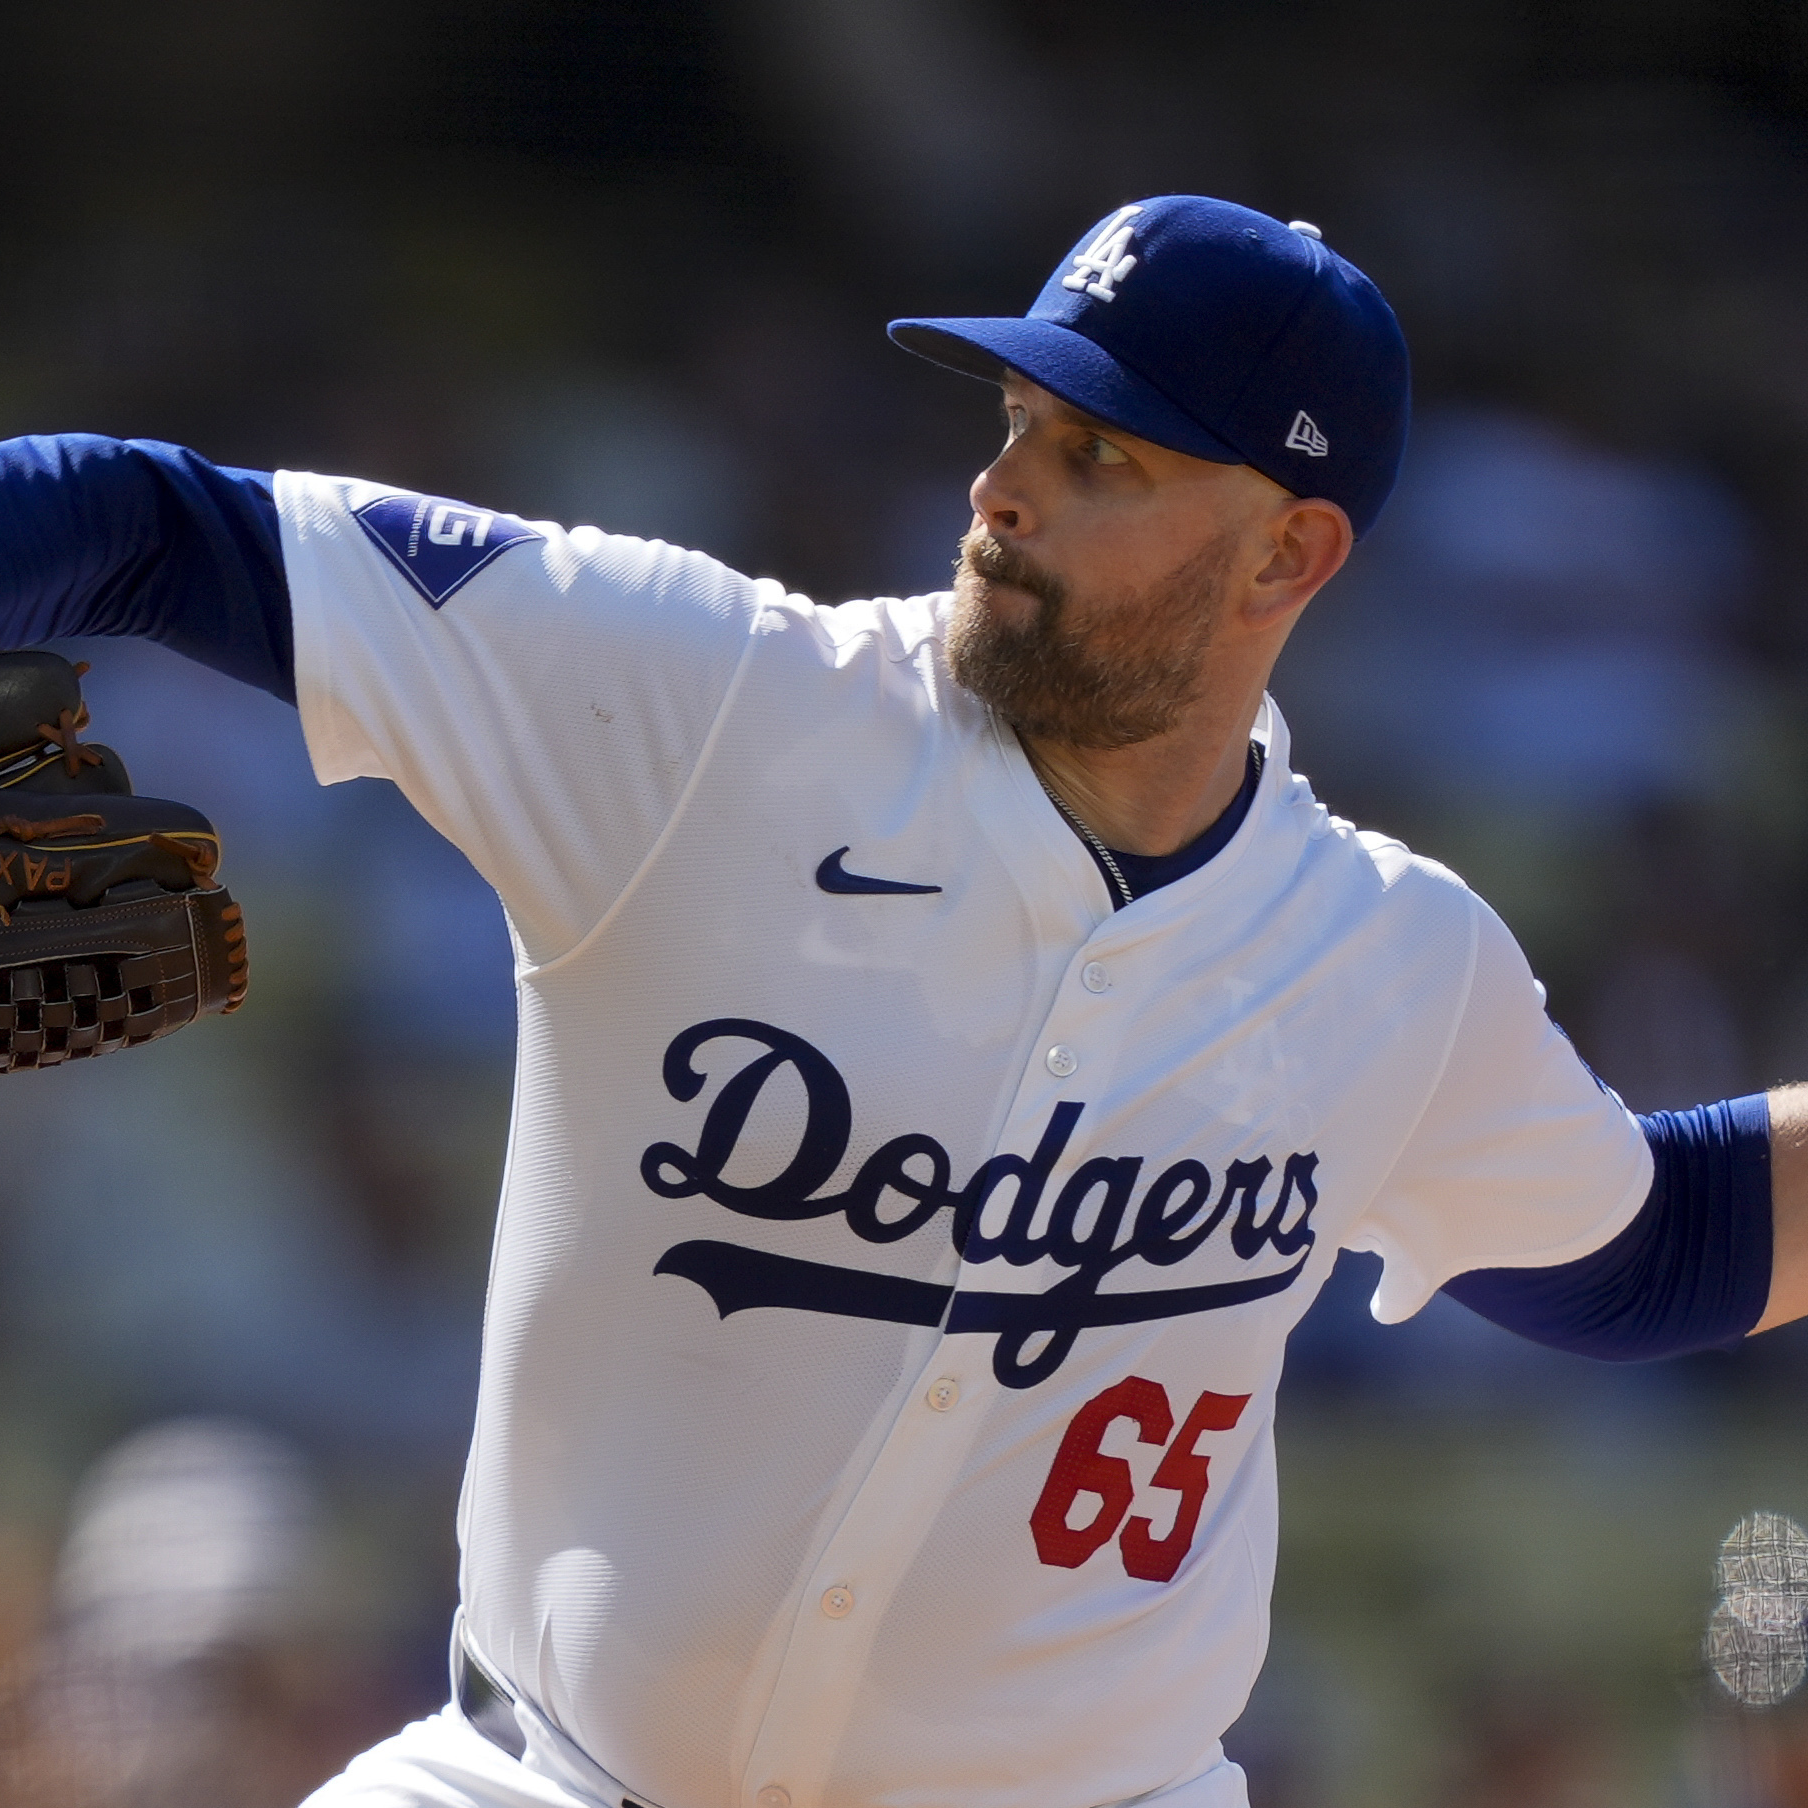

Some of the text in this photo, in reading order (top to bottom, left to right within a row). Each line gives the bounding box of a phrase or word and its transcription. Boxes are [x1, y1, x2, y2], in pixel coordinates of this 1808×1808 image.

[1062, 204, 1144, 302] LA
[640, 1017, 1320, 1390] Dodgers
[1029, 1375, 1253, 1583] 65
